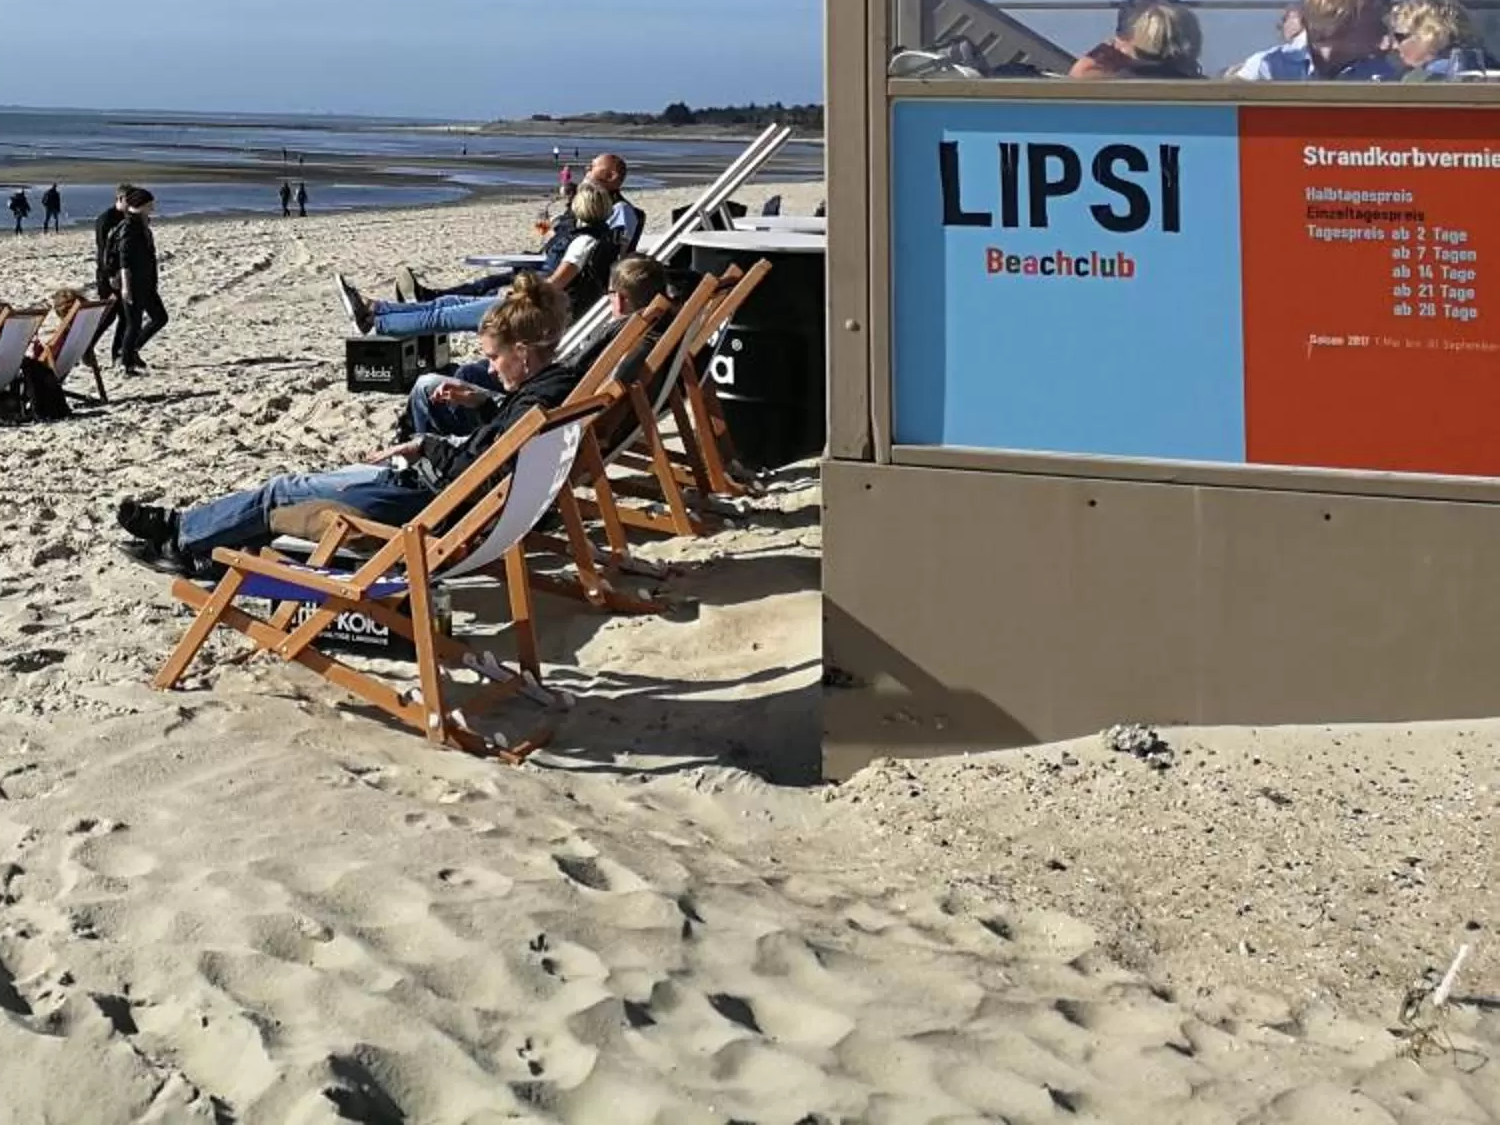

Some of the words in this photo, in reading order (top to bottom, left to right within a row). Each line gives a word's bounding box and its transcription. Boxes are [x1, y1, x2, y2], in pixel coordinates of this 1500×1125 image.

[939, 141, 1180, 233] LIPSI
[1306, 187, 1413, 205] Halbtagespreis
[1307, 206, 1424, 223] Einzeltagespreis
[1307, 225, 1385, 244] Tagespreis
[1392, 227, 1410, 241] ab
[1417, 227, 1426, 241] 2
[1432, 227, 1468, 244] Tage
[1392, 246, 1411, 260] ab
[1417, 246, 1426, 260] 7
[986, 248, 1135, 277] Beachclub
[1392, 265, 1411, 279] ab
[1418, 265, 1434, 279] 14
[1393, 283, 1412, 297] ab
[1418, 284, 1434, 298] 21
[1393, 303, 1413, 317] ab
